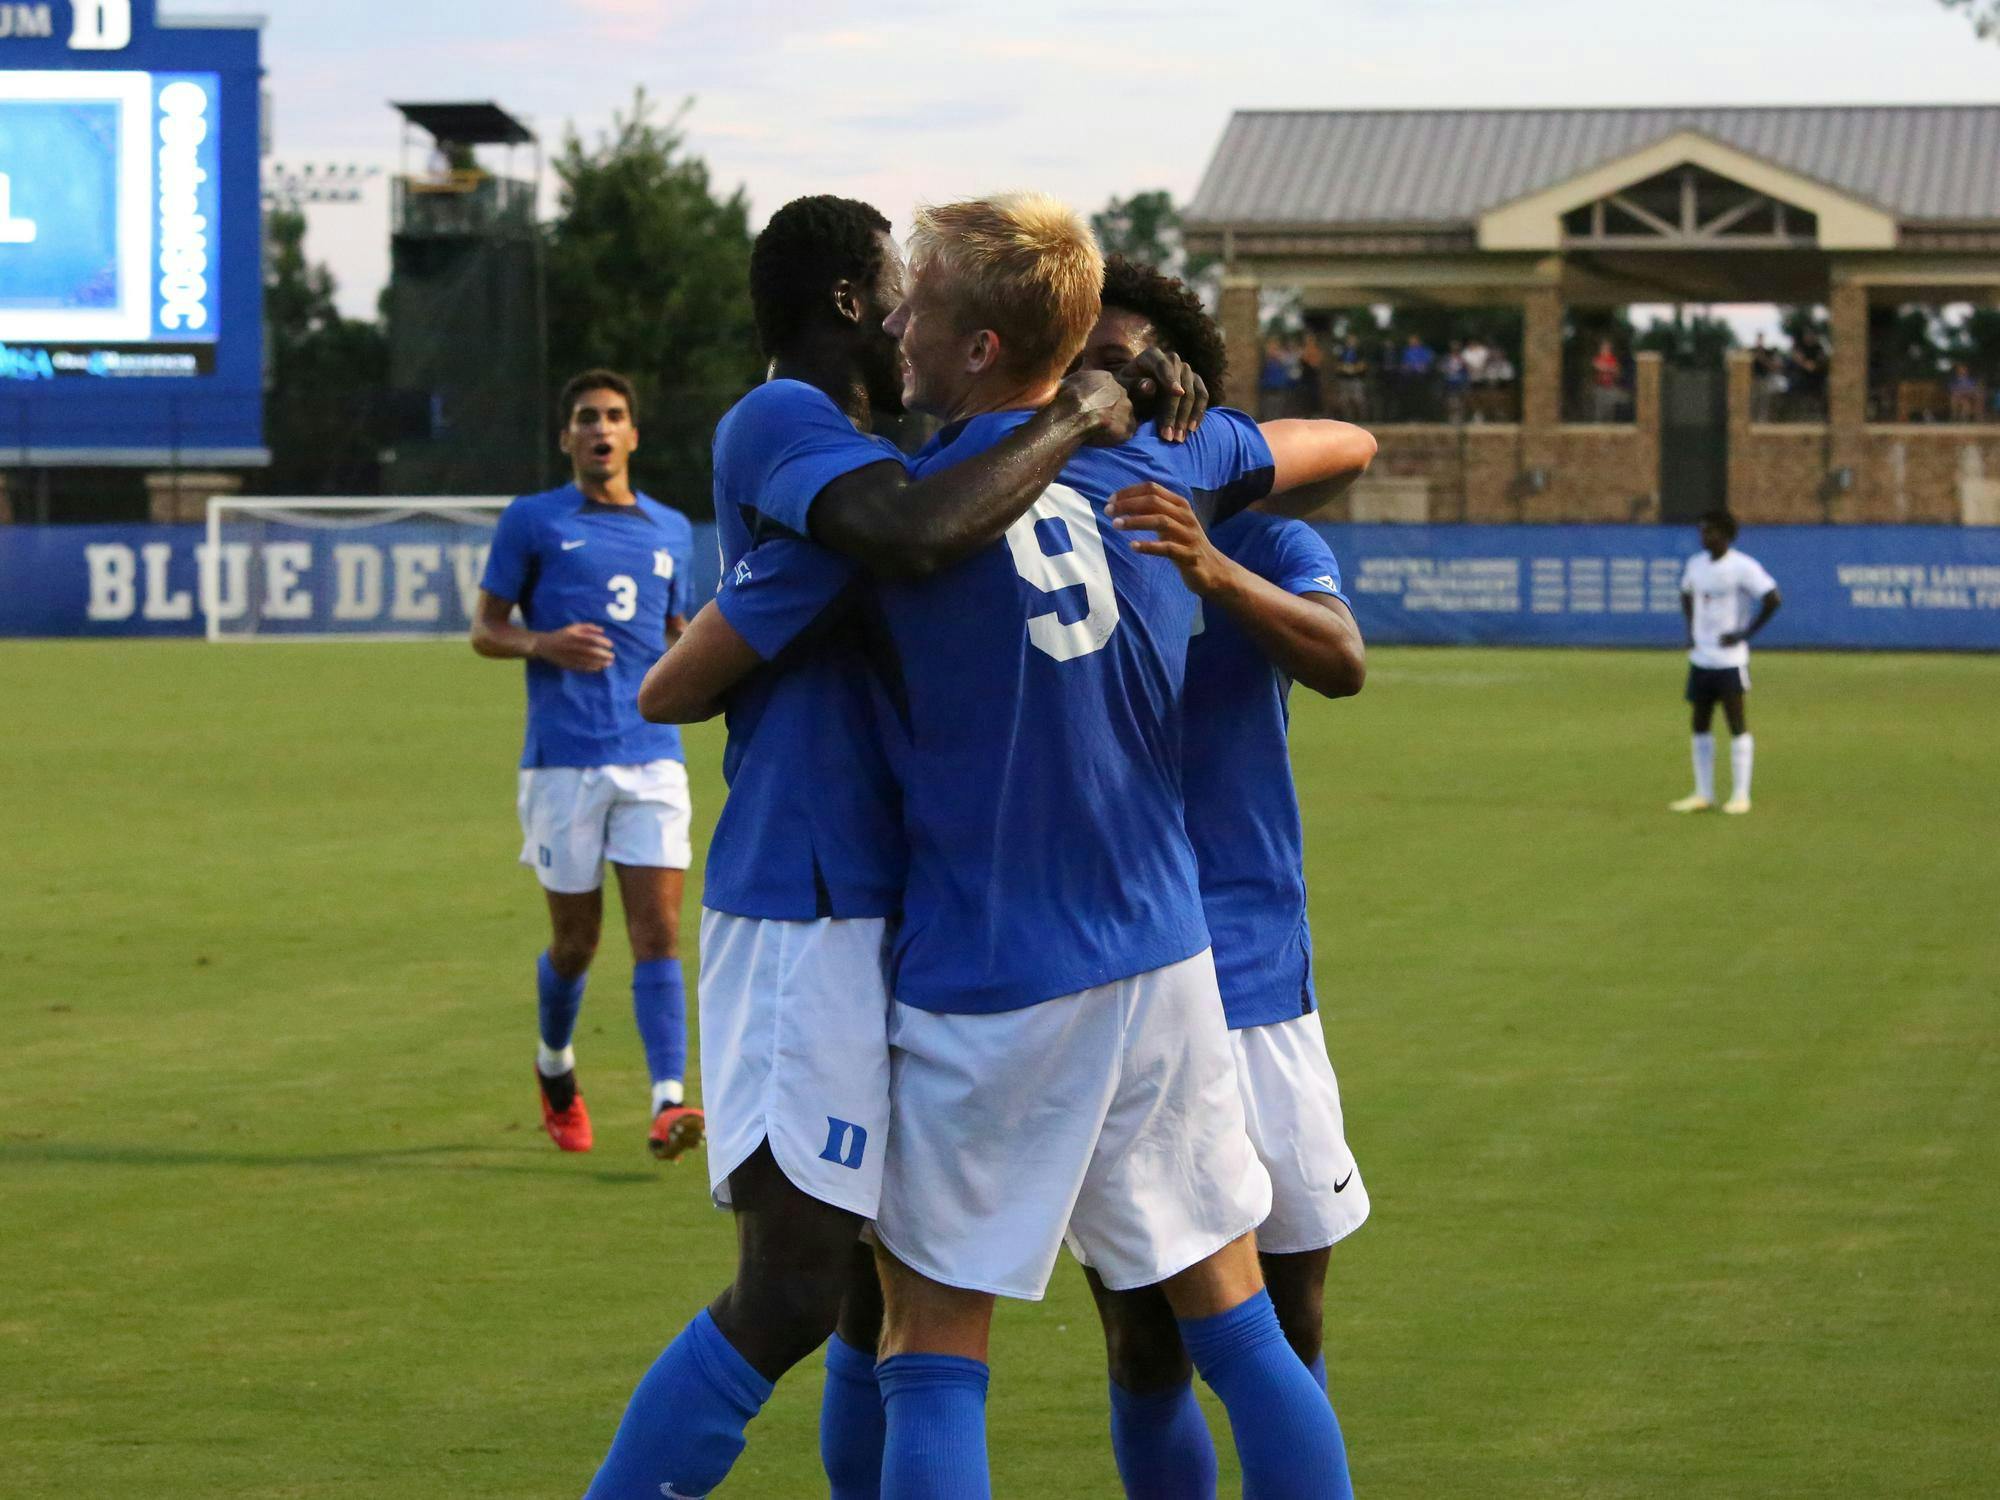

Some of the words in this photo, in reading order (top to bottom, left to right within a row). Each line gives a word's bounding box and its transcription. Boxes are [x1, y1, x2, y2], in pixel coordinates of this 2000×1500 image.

[67, 0, 131, 50] D
[85, 542, 313, 620] BLUE
[333, 542, 523, 622] DEV
[606, 574, 638, 622] 3
[1005, 482, 1120, 662] 9
[818, 1115, 868, 1170] D
